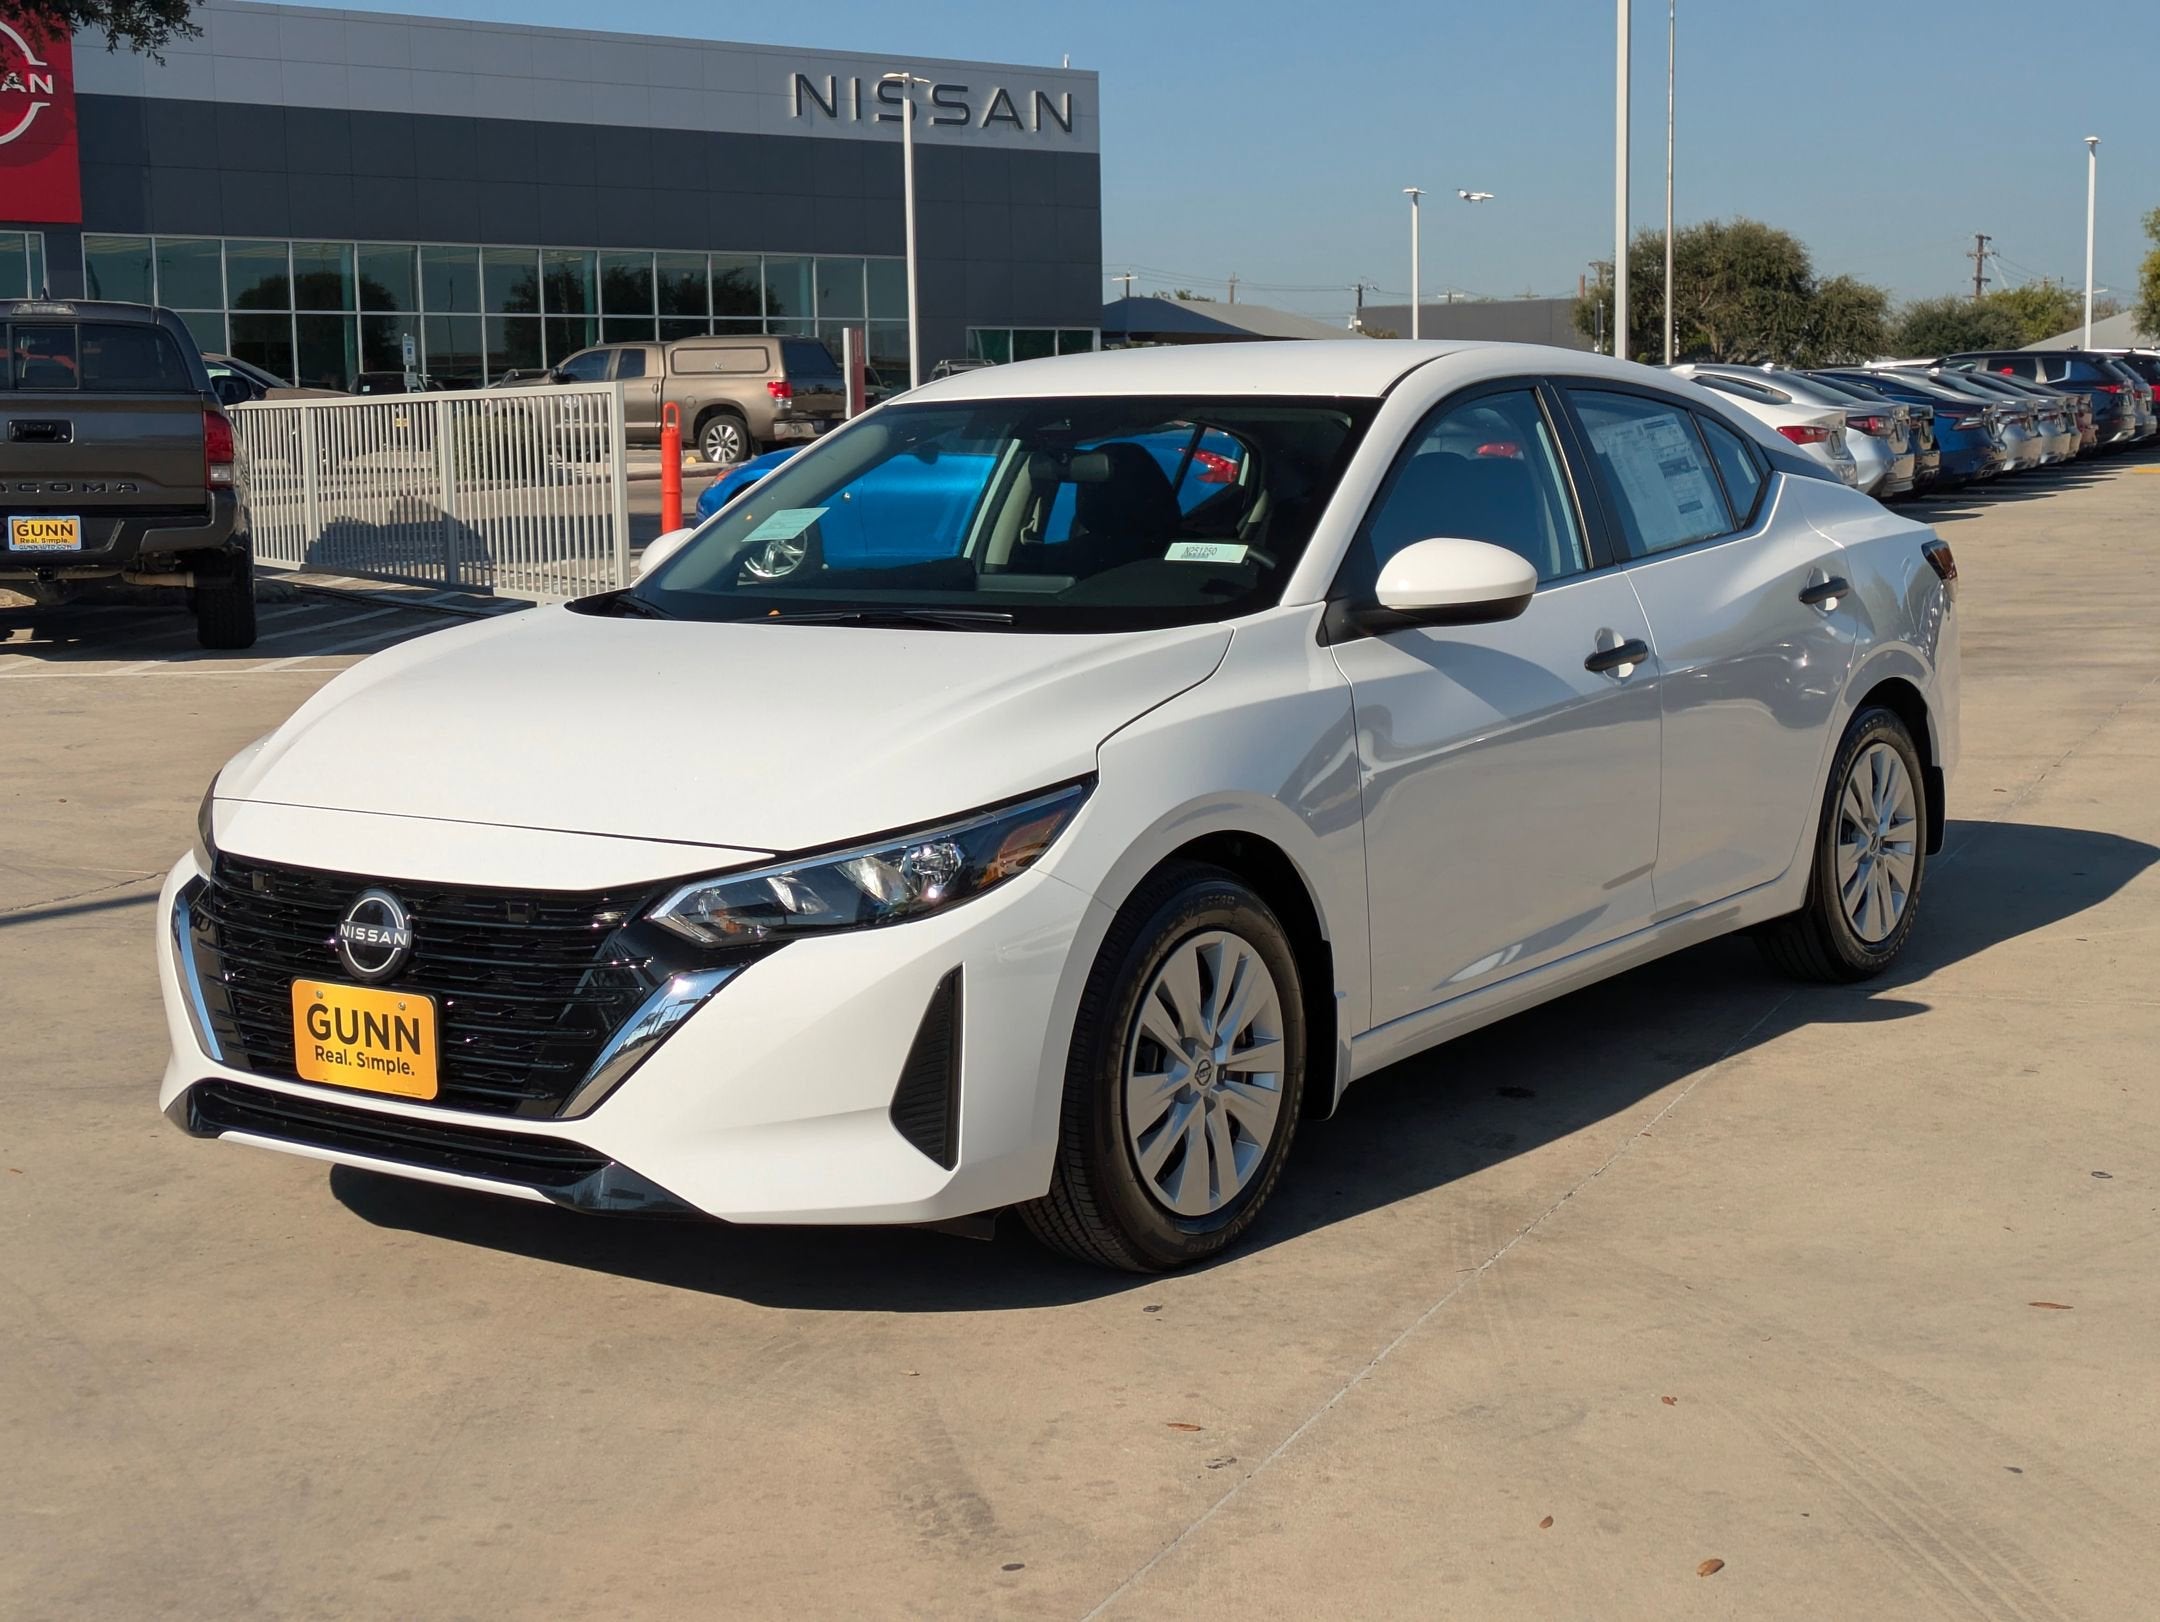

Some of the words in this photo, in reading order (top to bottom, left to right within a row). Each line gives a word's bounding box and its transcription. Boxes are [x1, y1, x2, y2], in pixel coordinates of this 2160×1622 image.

[791, 71, 1072, 133] NISSAN
[16, 523, 74, 537] GUNN
[339, 923, 407, 946] NISSAN
[306, 1002, 421, 1056] GUNN
[314, 1044, 352, 1067] Real.
